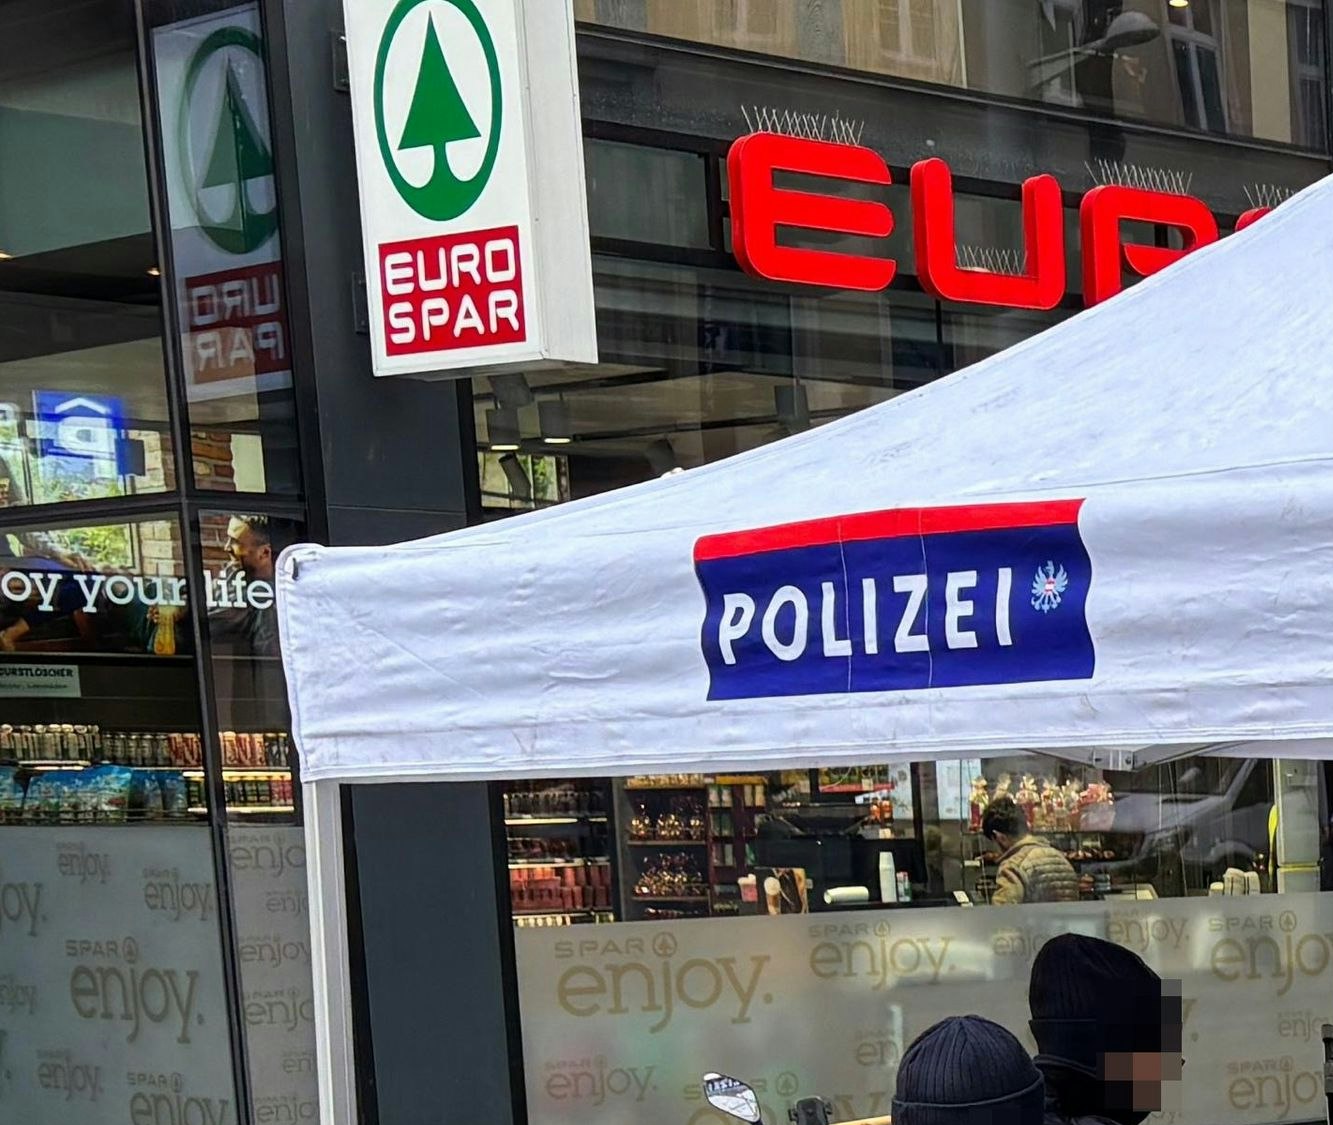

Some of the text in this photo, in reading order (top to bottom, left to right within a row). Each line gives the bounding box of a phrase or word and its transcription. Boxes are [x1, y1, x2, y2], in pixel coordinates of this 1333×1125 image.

[728, 131, 1272, 309] EUR
[384, 238, 516, 296] EURO
[388, 289, 520, 345] SPAR
[74, 574, 187, 613] your
[203, 569, 274, 610] life
[718, 567, 1013, 665] POLIZEI
[65, 939, 118, 958] SPAR
[554, 936, 645, 960] SPAR
[808, 923, 869, 938] SPAR
[1208, 914, 1275, 933] SPAR
[808, 935, 957, 991] enjoy.
[70, 964, 204, 1044] enjoy.
[557, 954, 774, 1035] enjoy.
[127, 1071, 167, 1087] SPAR
[1228, 1071, 1324, 1120] enjo
